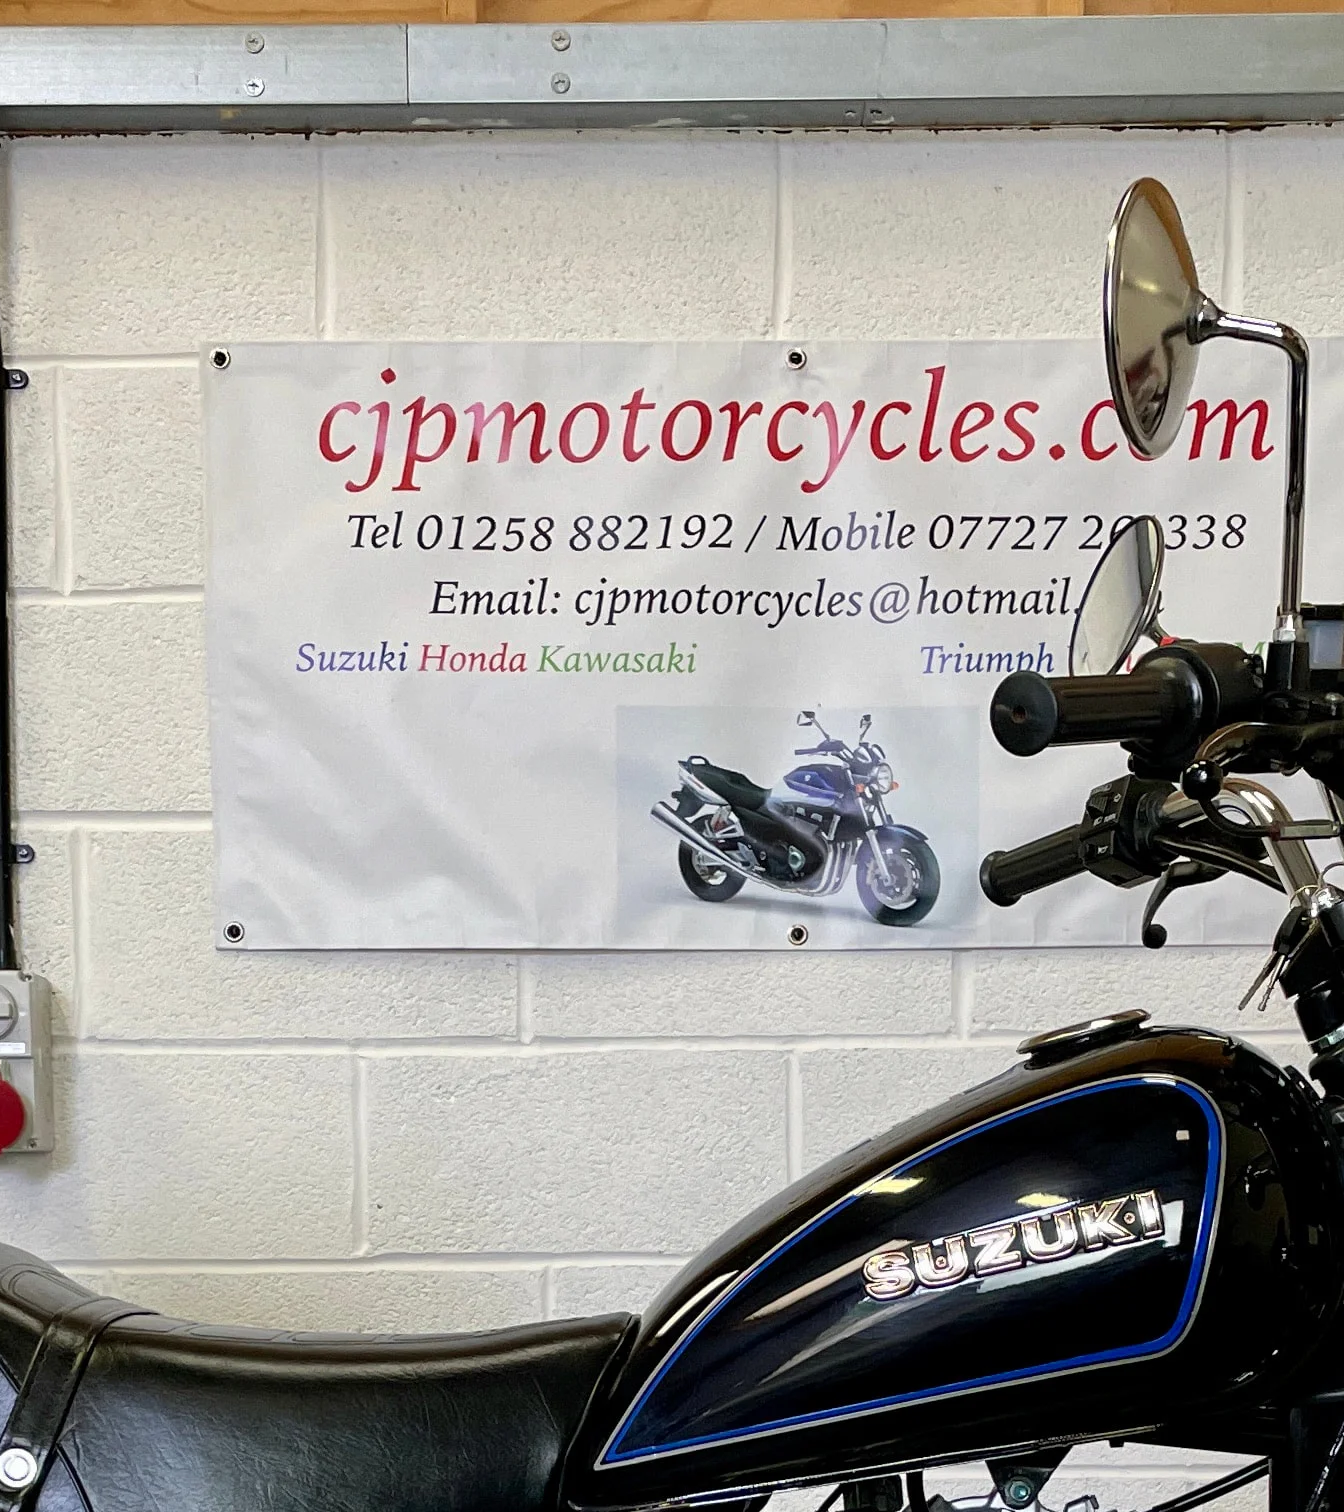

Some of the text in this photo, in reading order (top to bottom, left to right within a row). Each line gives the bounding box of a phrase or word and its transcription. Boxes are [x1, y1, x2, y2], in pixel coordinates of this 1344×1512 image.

[318, 365, 1275, 493] cjpmotorcycles.cm
[347, 510, 1248, 553] Tel 01258 882192 / Mobile 07727 2338
[429, 575, 1165, 629] Email: cjpmotorcycles@hotmail.
[295, 641, 698, 674] Suzuki Honda Kawasaki
[920, 641, 1055, 674] Triumph
[861, 1189, 1165, 1301] SUZUKI
